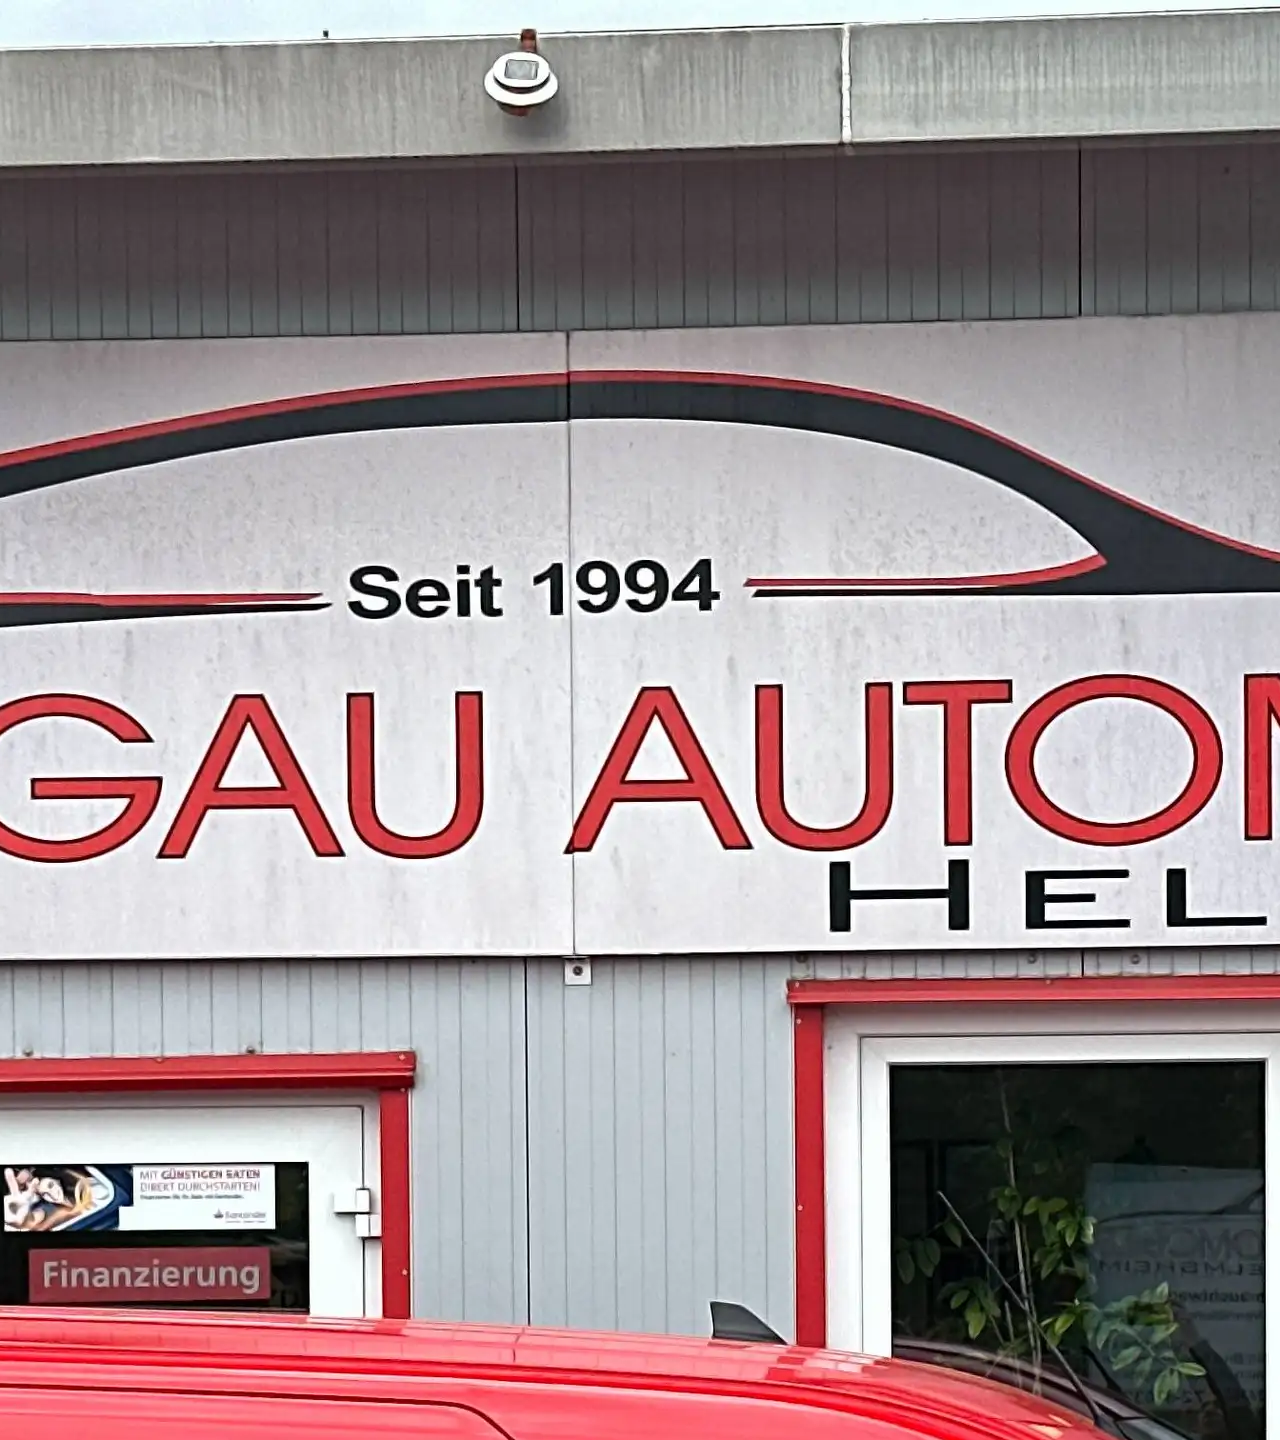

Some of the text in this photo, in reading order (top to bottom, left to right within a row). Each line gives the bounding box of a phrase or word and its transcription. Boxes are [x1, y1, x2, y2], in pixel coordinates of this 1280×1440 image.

[347, 558, 721, 619] Seit 1994
[139, 1170, 158, 1180] MIT
[139, 1182, 175, 1192] DIREKT
[42, 1258, 261, 1295] Finanzierung
